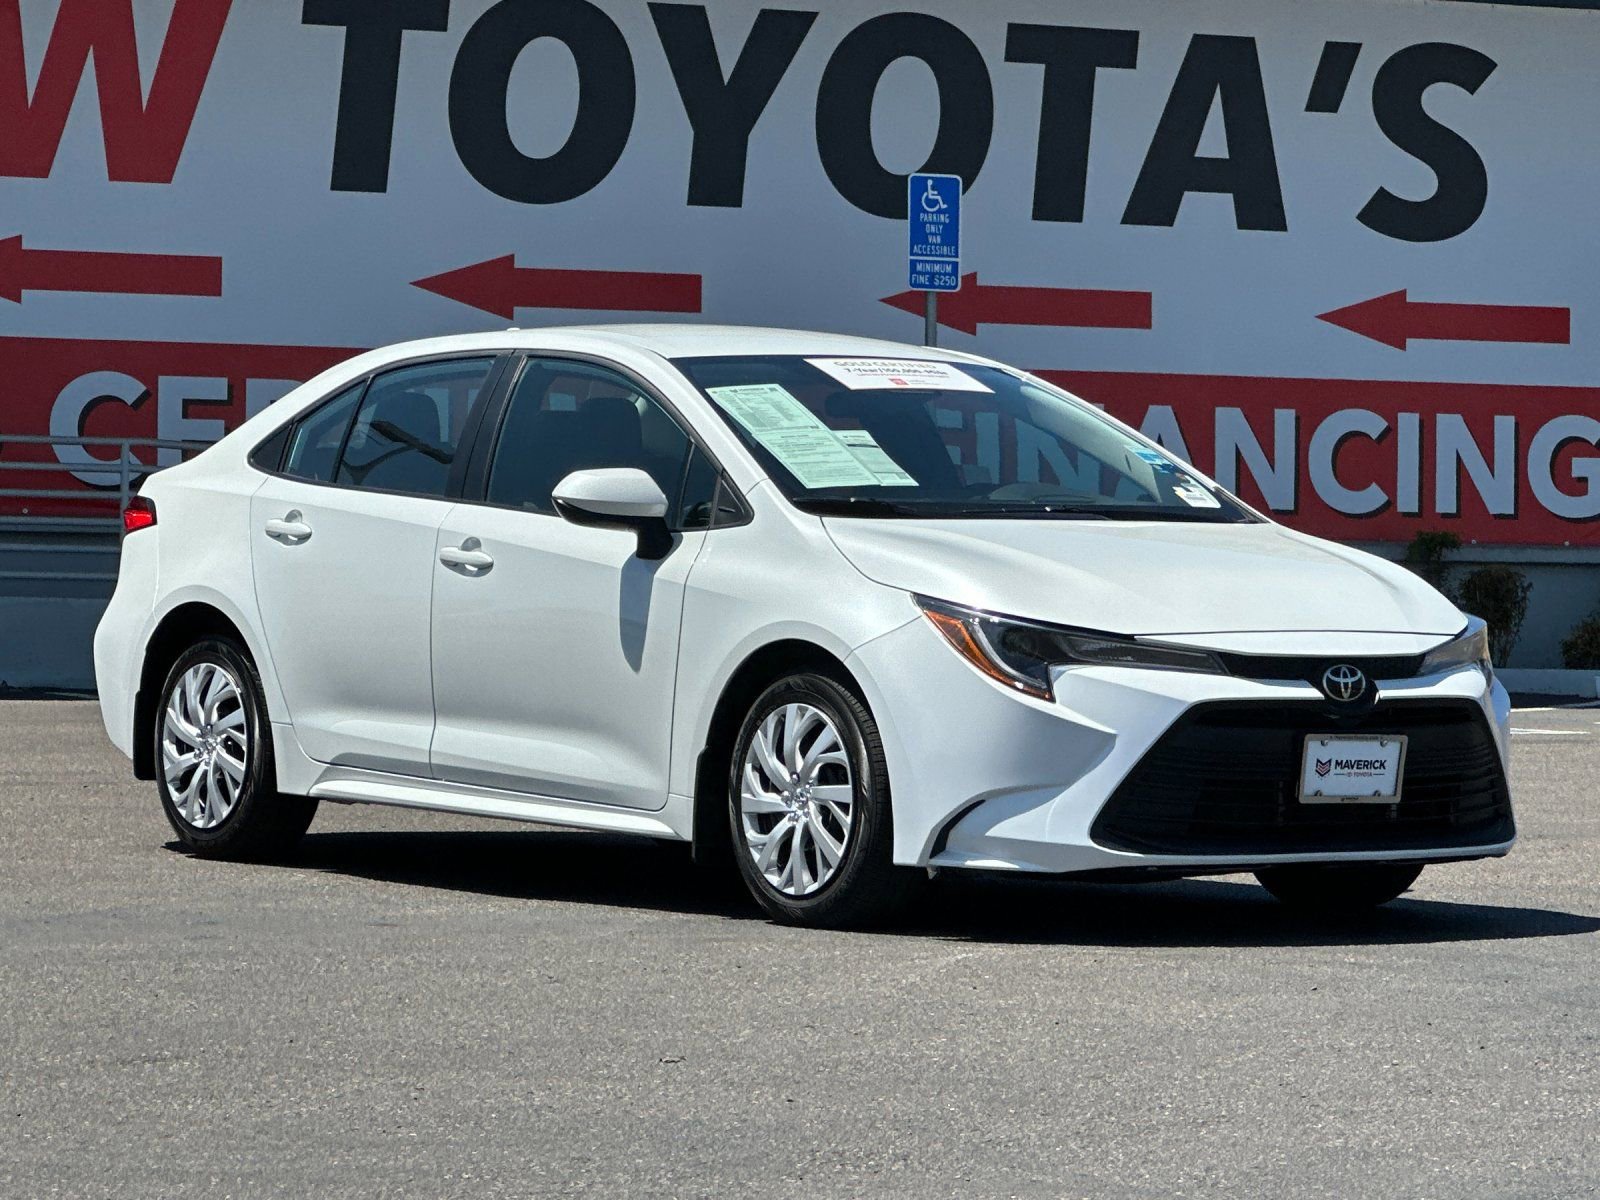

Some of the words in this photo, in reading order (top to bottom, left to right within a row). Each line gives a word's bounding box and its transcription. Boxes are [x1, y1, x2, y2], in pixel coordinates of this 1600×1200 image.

[301, 0, 1498, 243] TOYOTA'S
[919, 212, 950, 224] PARKING
[925, 224, 943, 234] ONLY
[927, 235, 941, 244] VAN
[913, 244, 956, 256] ACCESSIBLE
[916, 262, 952, 273] MINIMUM
[911, 274, 930, 285] FINE
[933, 275, 956, 287] $250
[1334, 759, 1387, 770] MAVERICK
